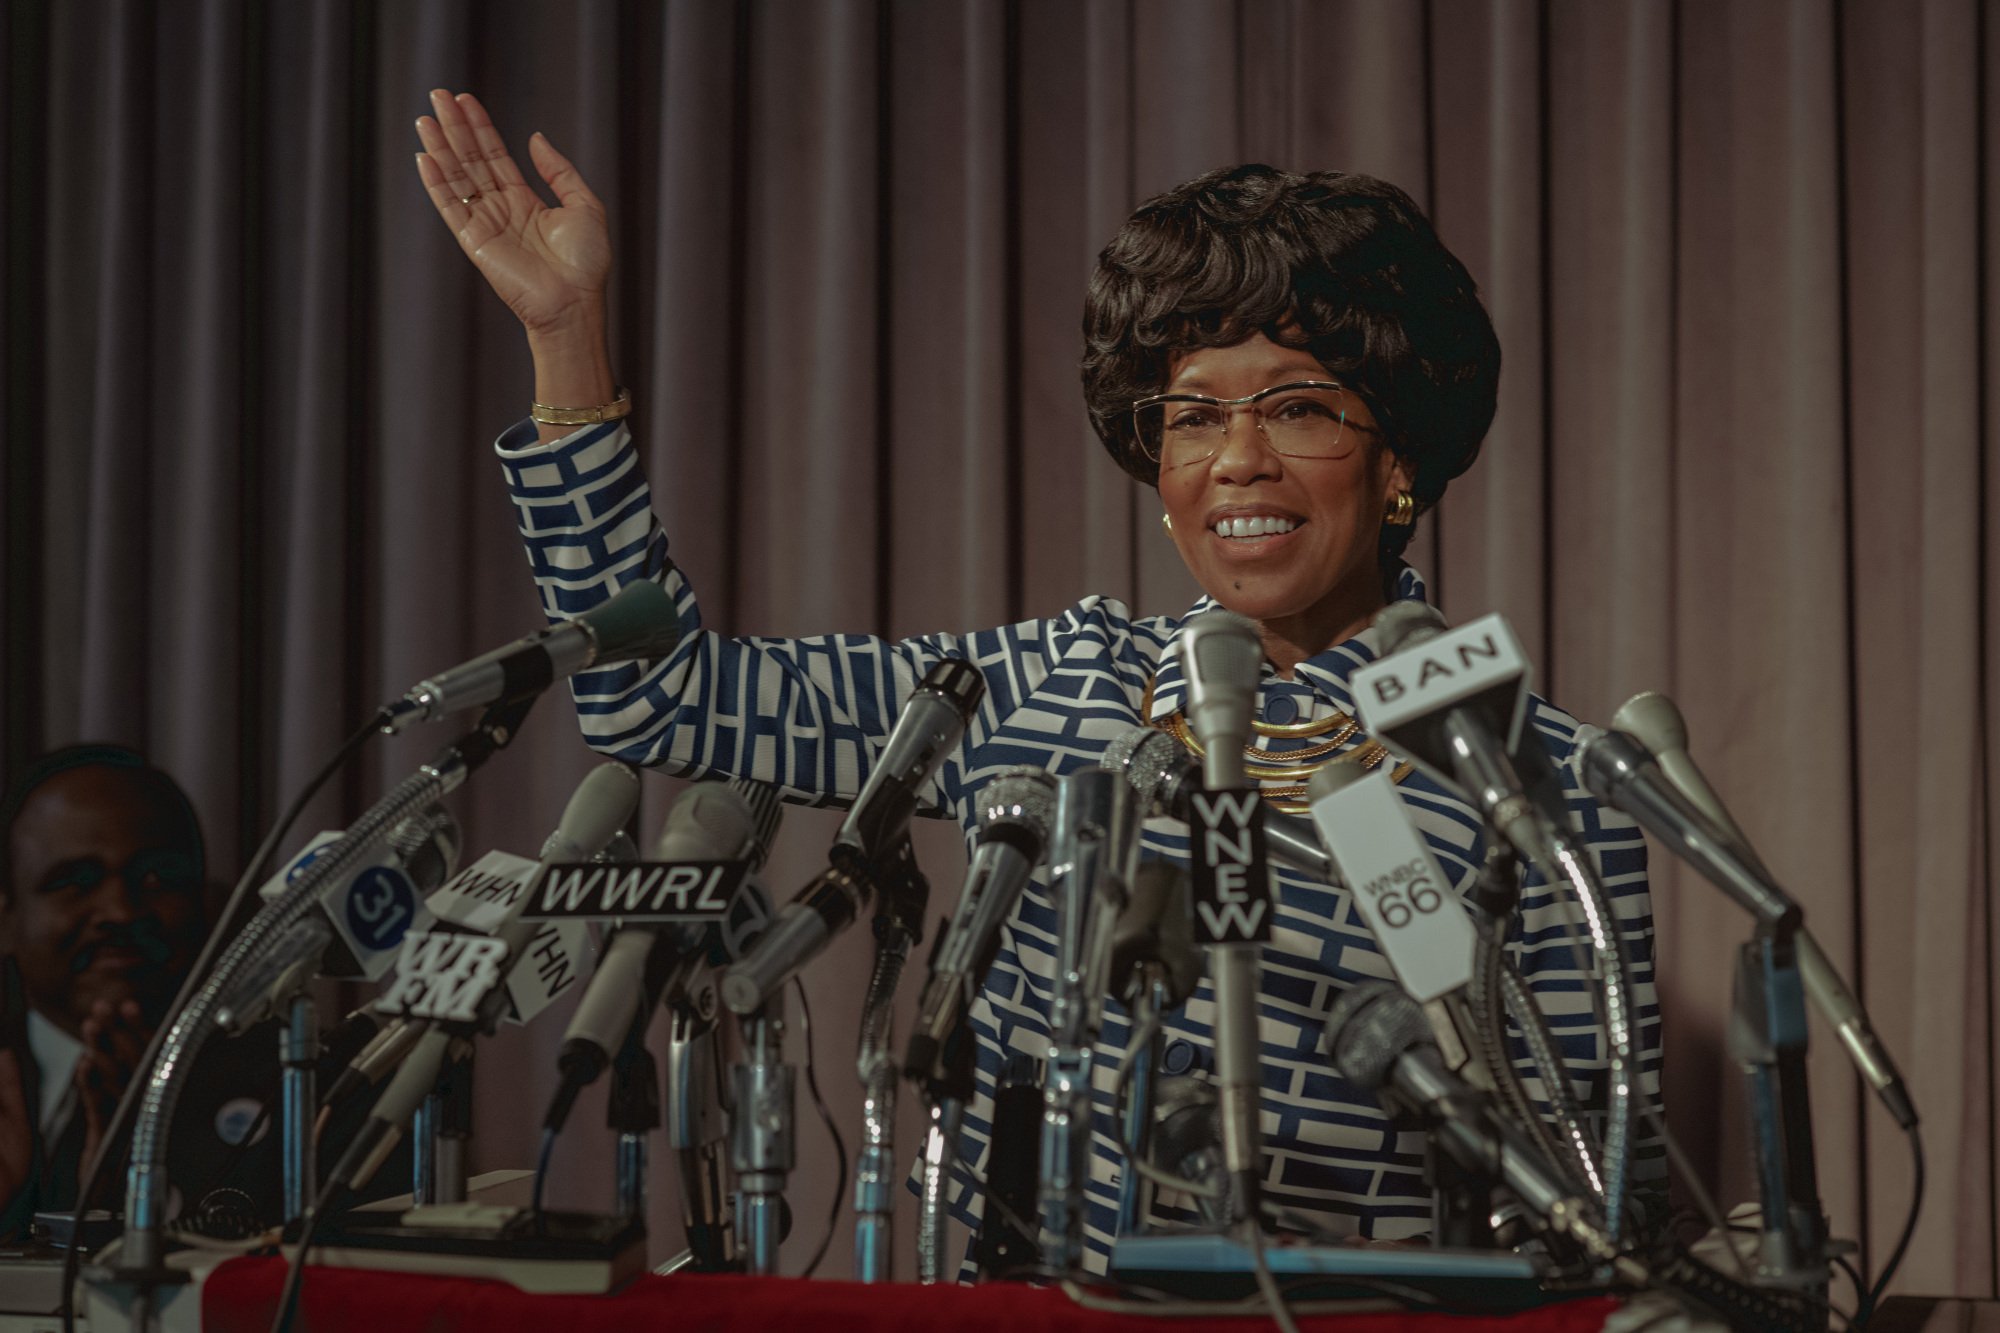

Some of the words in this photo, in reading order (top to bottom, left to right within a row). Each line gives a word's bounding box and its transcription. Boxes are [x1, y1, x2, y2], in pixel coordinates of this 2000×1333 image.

[1374, 634, 1499, 704] BAN
[541, 866, 729, 912] WWRL
[1192, 792, 1266, 940] WNEW
[1362, 857, 1430, 898] WNBC
[353, 873, 407, 941] 31
[1376, 878, 1443, 930] 66
[374, 973, 496, 1022] FM
